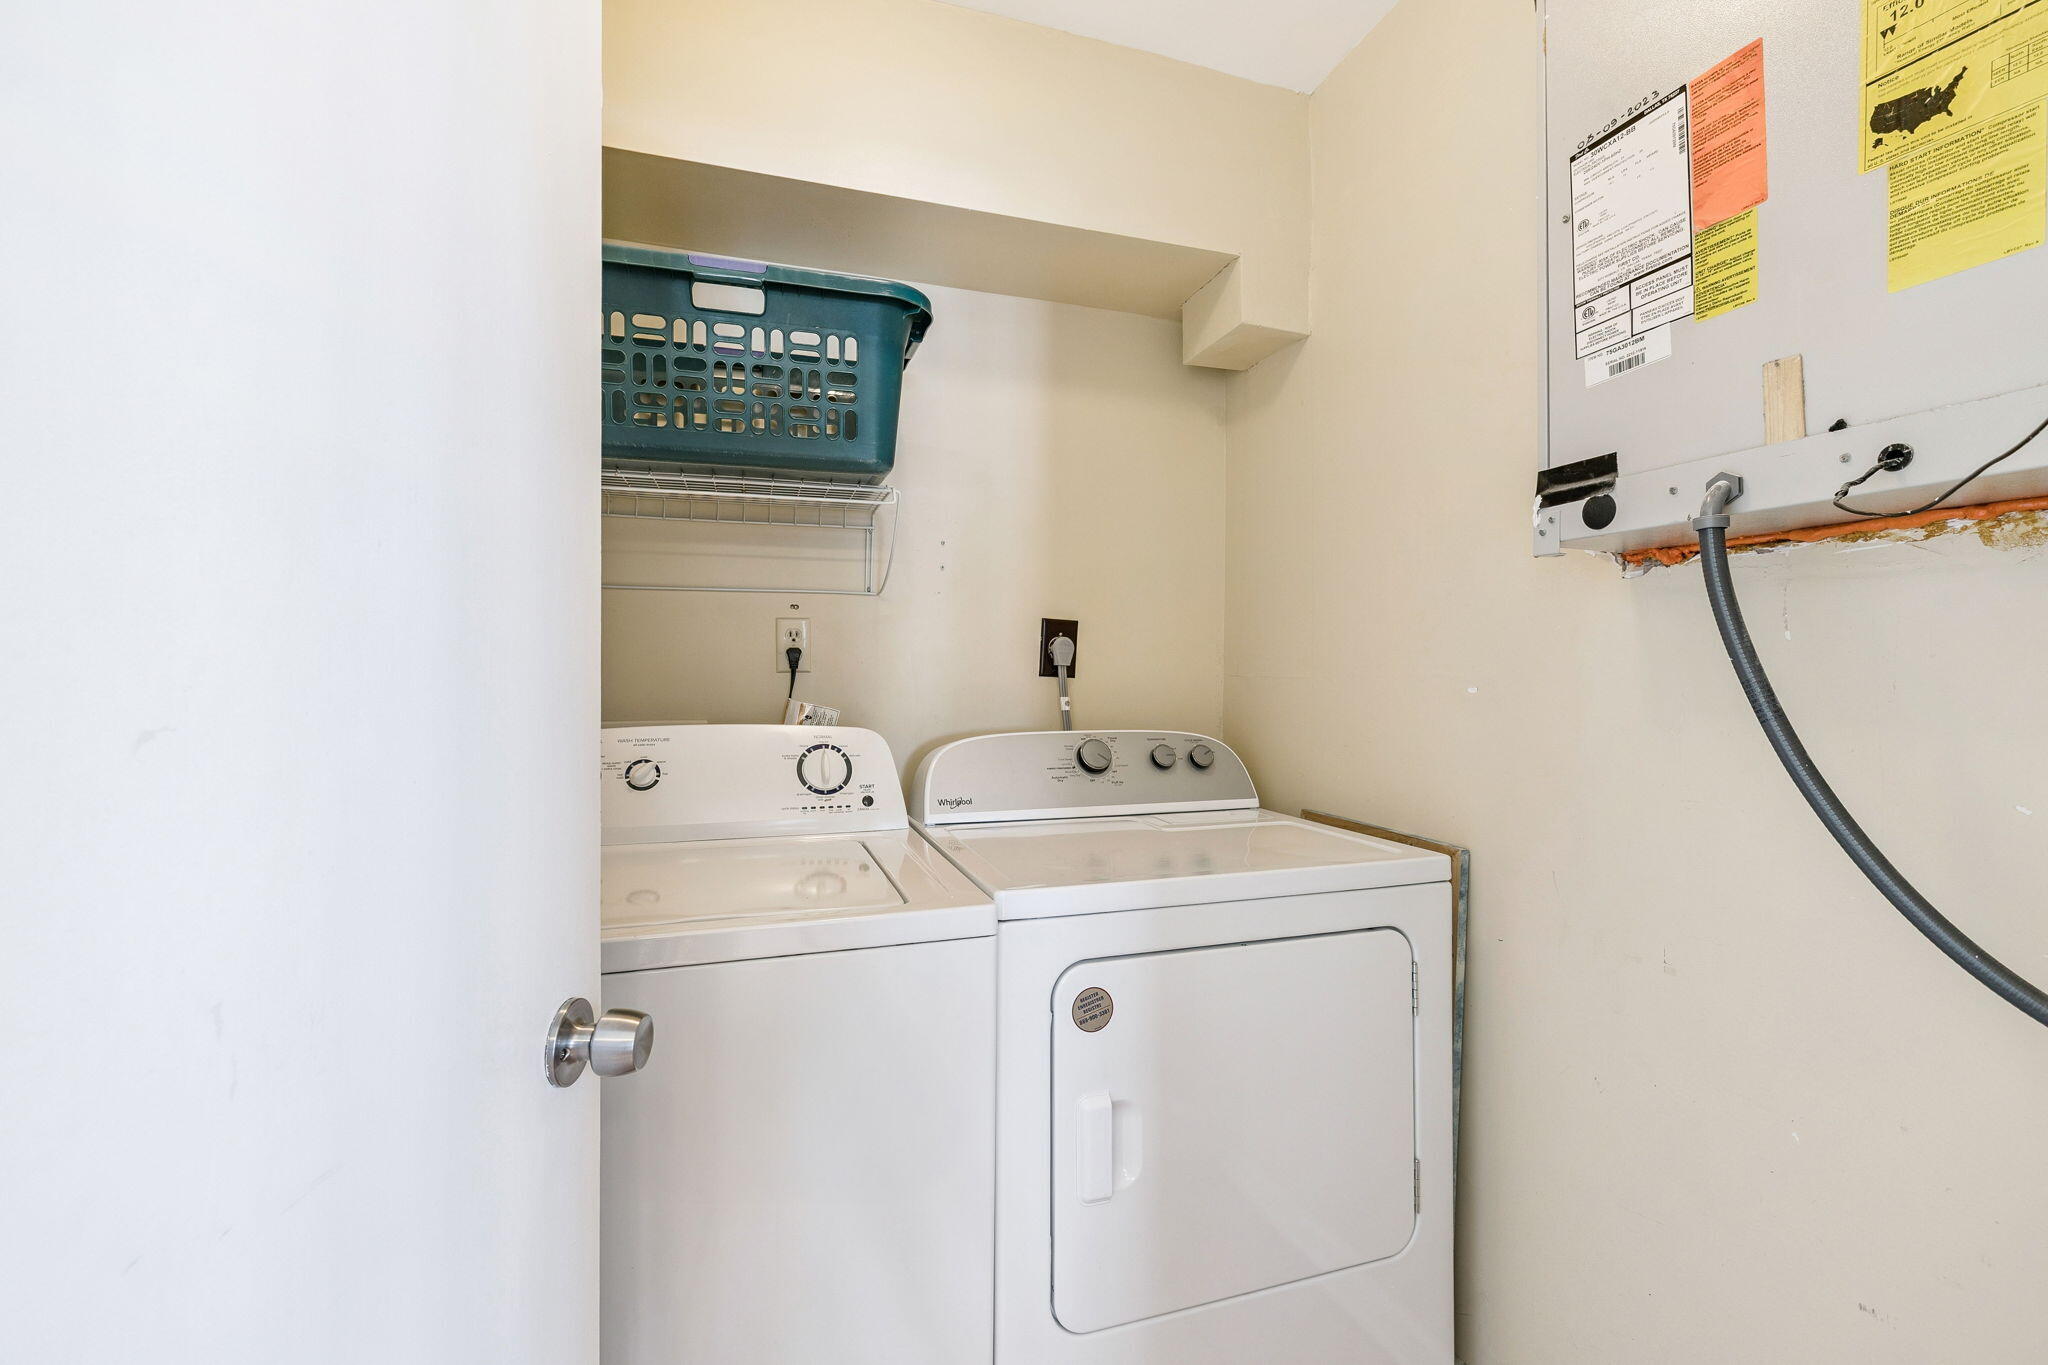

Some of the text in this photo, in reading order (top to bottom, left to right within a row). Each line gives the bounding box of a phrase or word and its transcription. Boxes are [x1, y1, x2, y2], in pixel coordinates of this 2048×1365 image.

[1890, 0, 1924, 21] 12.0
[1897, 45, 1916, 60] Range
[1878, 74, 1899, 89] Notice
[1890, 160, 1908, 172] HARD
[1911, 150, 1931, 163] START
[1646, 242, 1690, 267] DOCUMENTATION
[1635, 279, 1655, 292] ACCESS
[1656, 271, 1672, 282] PANEL
[1674, 264, 1688, 275] MUST
[1650, 280, 1665, 291] PLACE
[1666, 270, 1688, 284] BEFORE
[1640, 278, 1682, 300] OPERATING UNIT
[1606, 335, 1645, 356] 75GA3012BM
[937, 796, 972, 809] Whirlpool
[1080, 992, 1098, 1002] REGISTER
